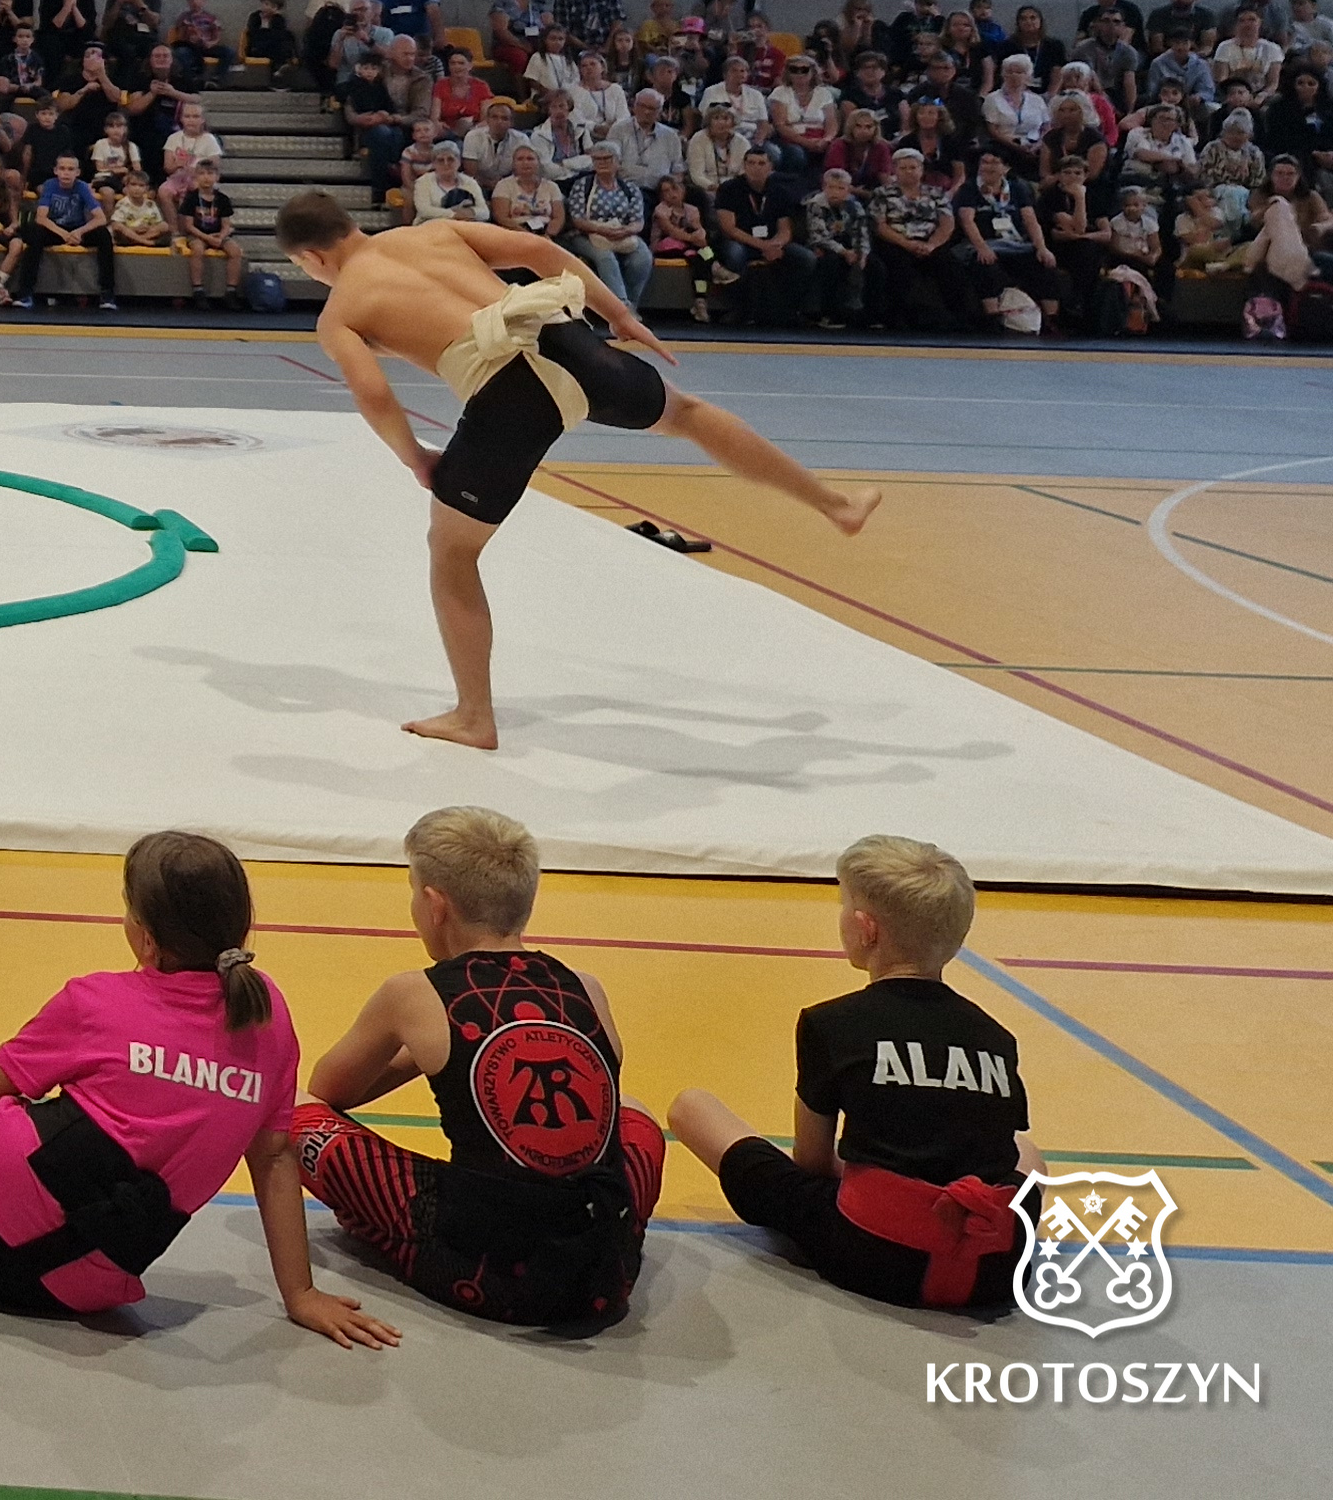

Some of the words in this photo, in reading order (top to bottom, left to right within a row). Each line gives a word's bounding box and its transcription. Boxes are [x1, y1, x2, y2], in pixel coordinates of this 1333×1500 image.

[129, 1041, 263, 1103] BLANCZI
[872, 1040, 1011, 1098] ALAN
[300, 1124, 336, 1176] TICO
